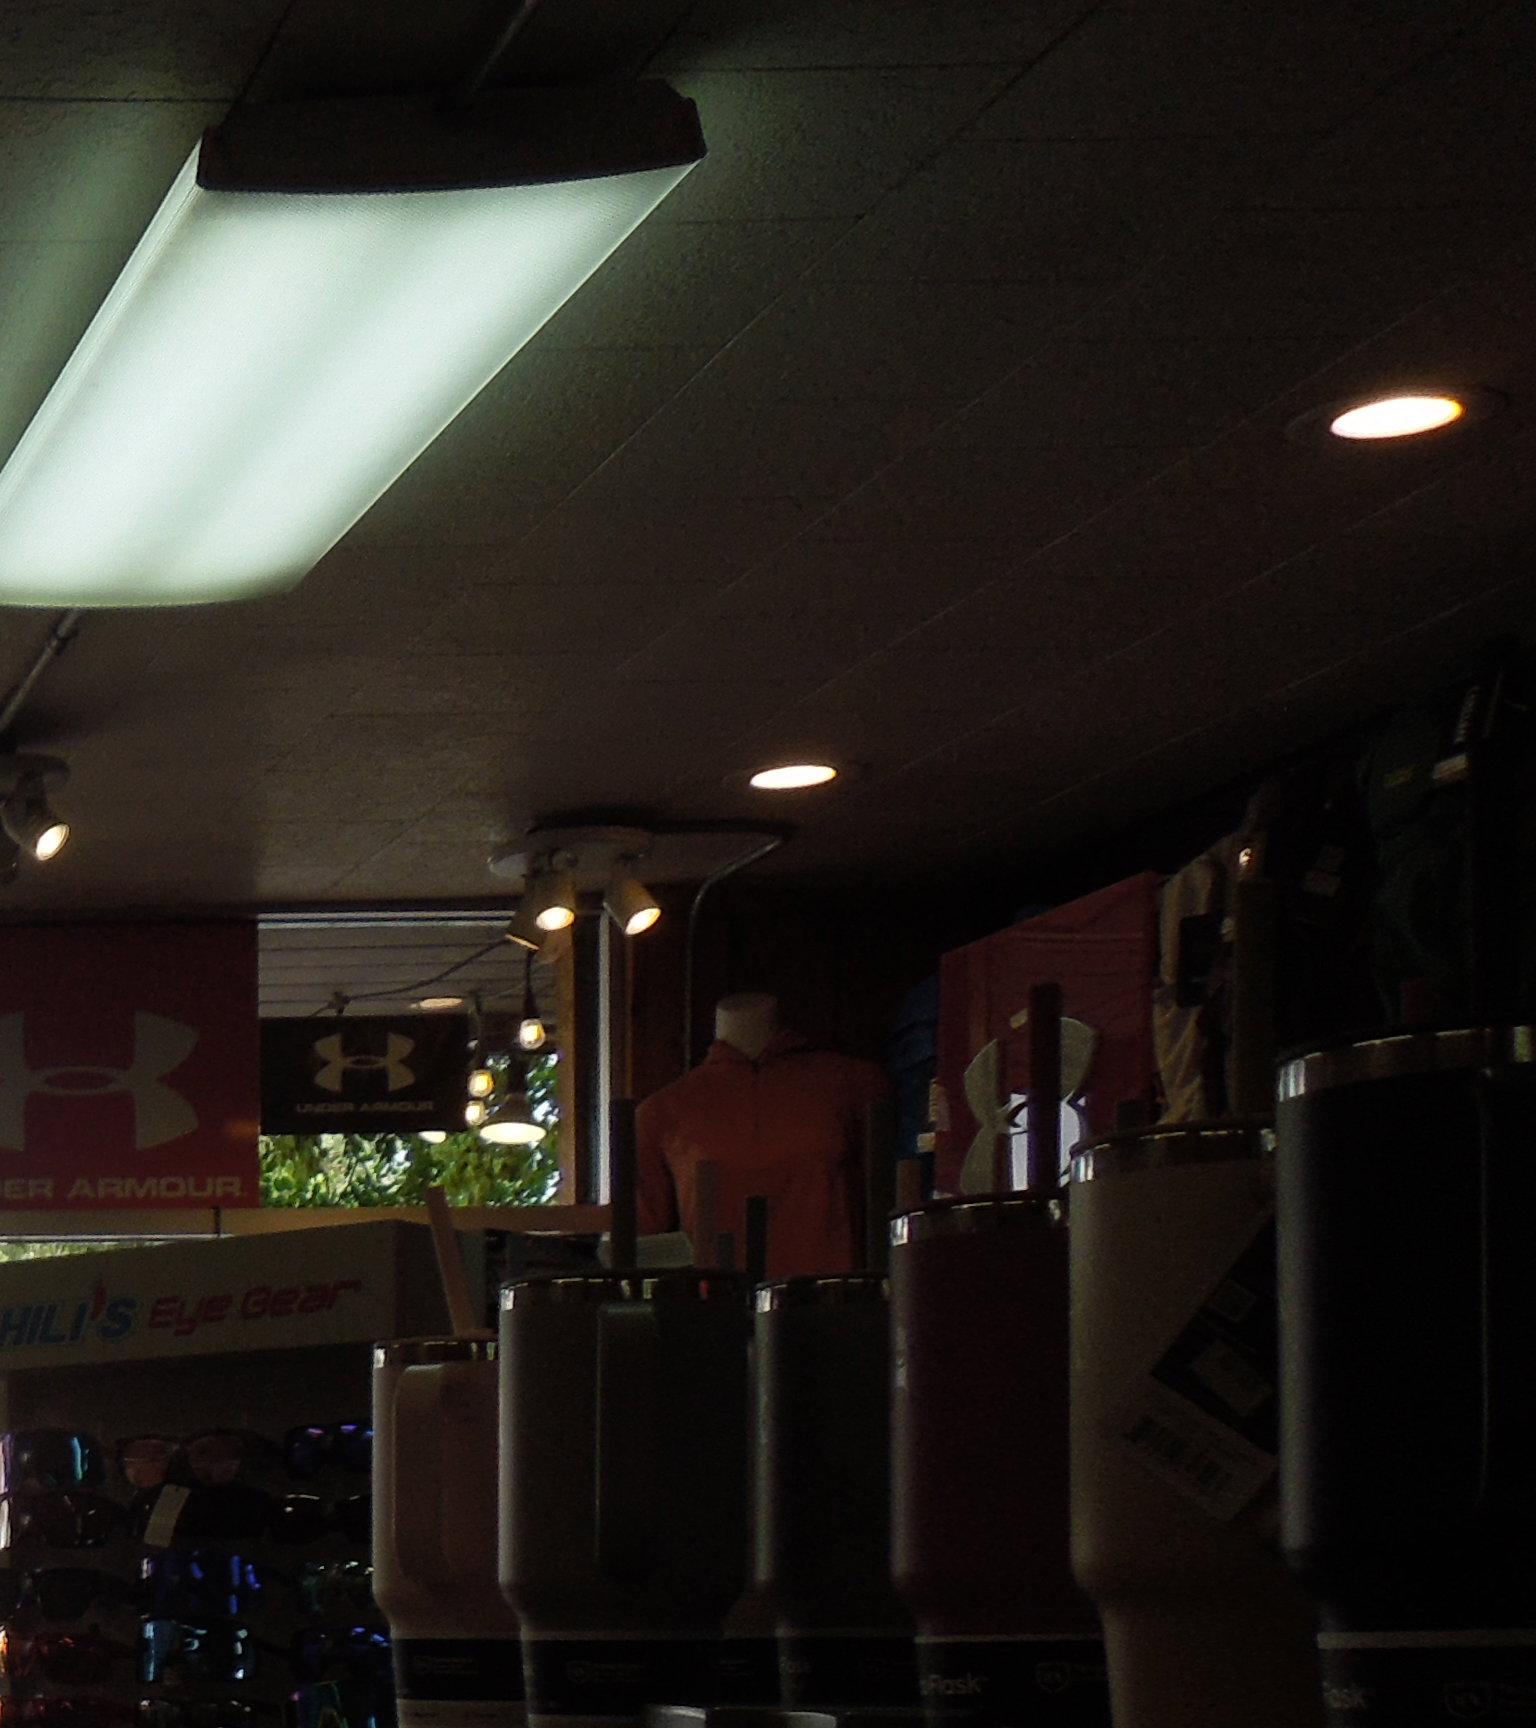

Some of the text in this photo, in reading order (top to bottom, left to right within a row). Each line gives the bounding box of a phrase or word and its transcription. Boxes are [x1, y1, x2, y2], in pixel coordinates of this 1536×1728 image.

[295, 1100, 434, 1114] UNDER ARMOUR
[67, 1175, 246, 1199] ARMOUR
[147, 1294, 233, 1338] Eye
[239, 1279, 364, 1321] Gear
